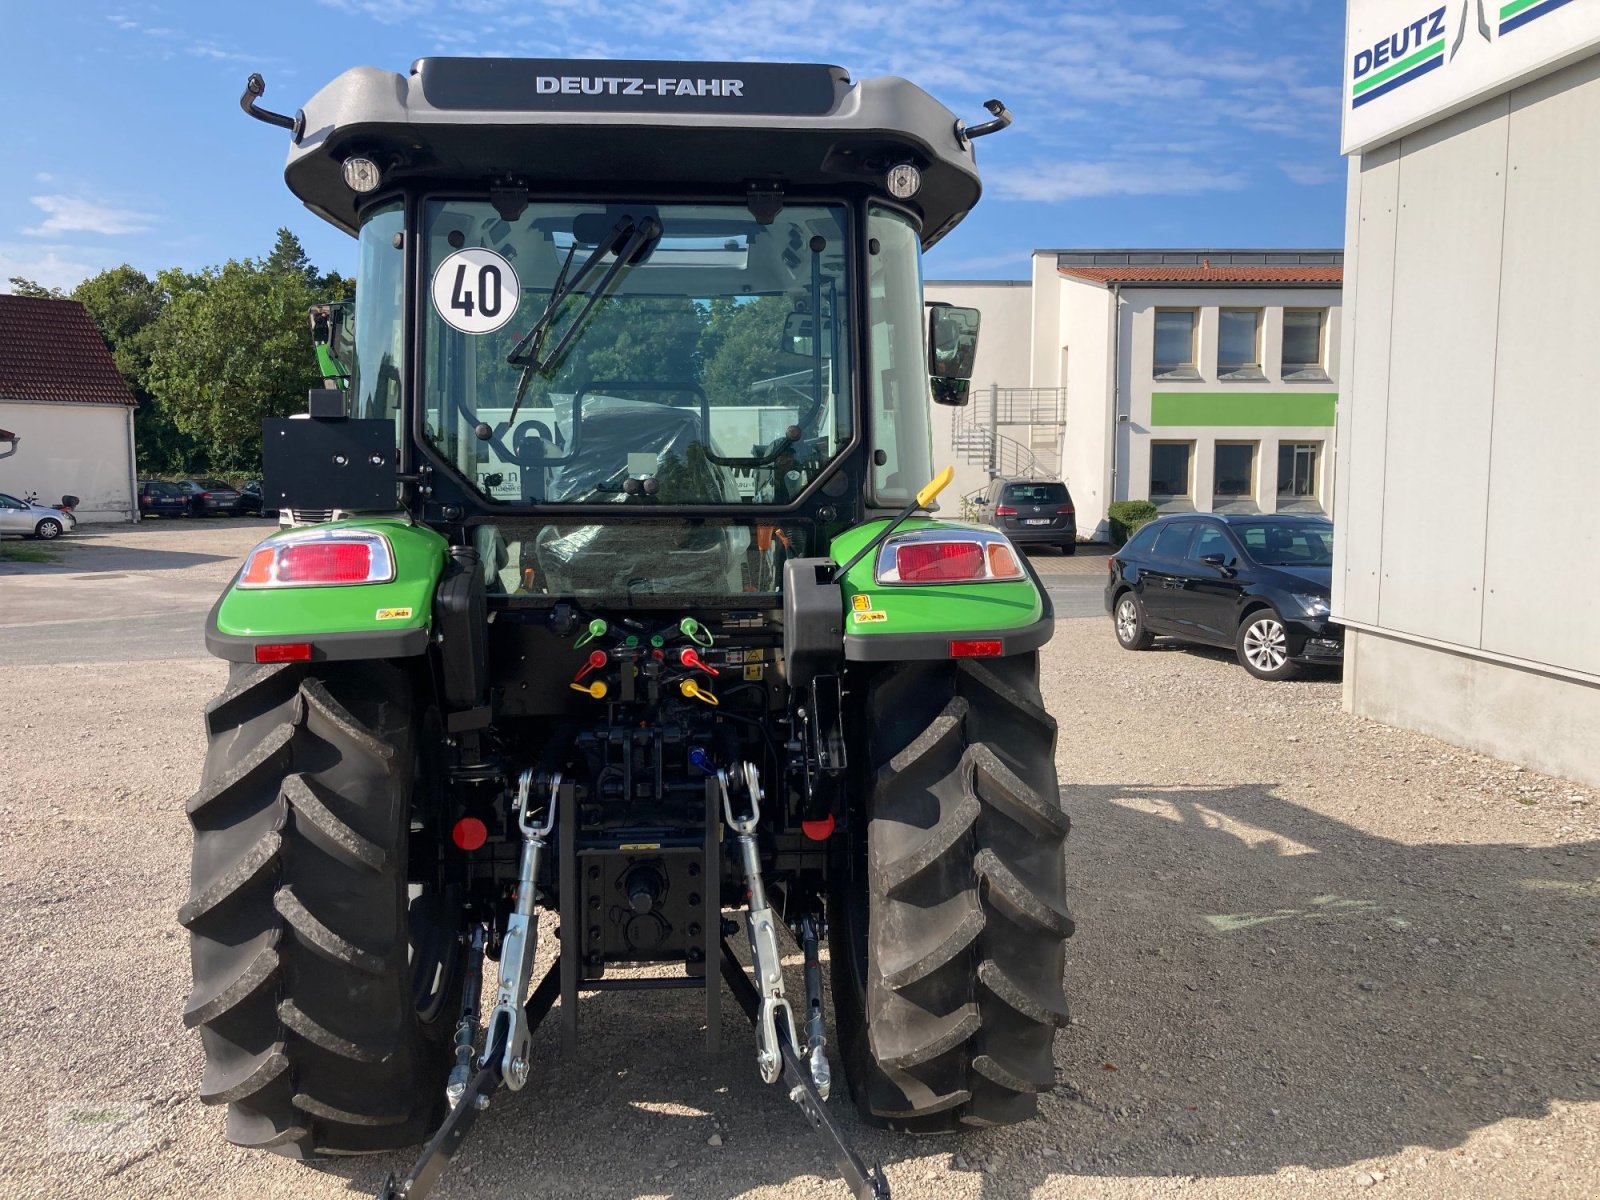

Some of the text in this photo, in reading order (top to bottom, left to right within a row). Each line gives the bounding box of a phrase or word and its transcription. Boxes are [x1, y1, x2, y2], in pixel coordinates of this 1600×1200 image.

[1353, 5, 1447, 80] DEUTZ
[536, 75, 745, 98] DEUTZ-FAHR
[450, 263, 502, 318] 40
